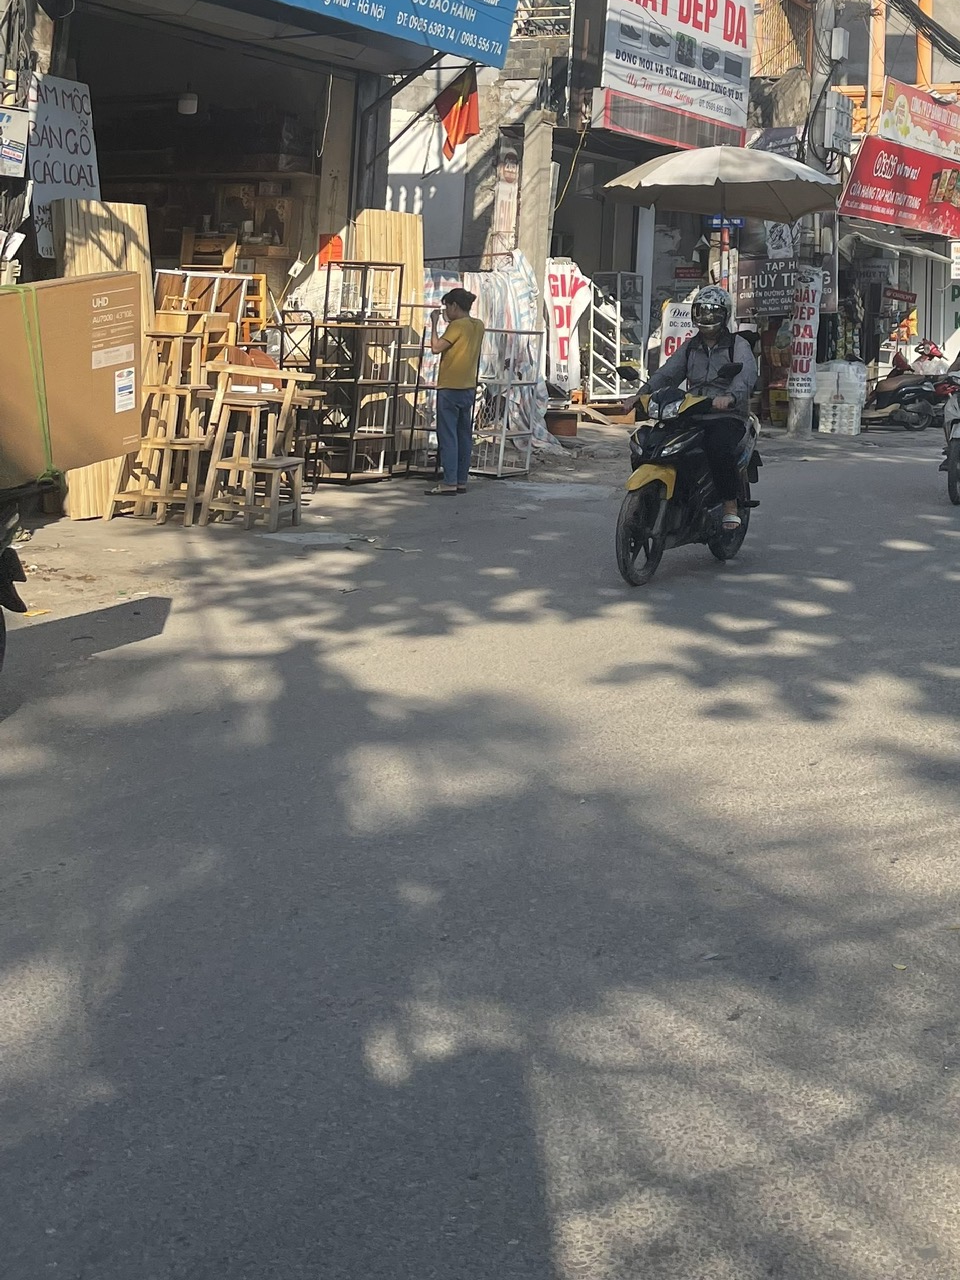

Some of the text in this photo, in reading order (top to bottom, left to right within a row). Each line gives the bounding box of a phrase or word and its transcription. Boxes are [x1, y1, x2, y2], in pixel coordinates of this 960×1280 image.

[370, 4, 386, 22] Nội
[445, 26, 456, 41] 74
[450, 0, 477, 23] HÀNH
[62, 87, 92, 120] MỘC
[28, 114, 92, 156] BÁN GỖ
[32, 153, 62, 185] CÁC
[63, 163, 97, 191] LOẠI
[766, 261, 785, 273] TẠP
[740, 271, 778, 290] THÙY
[92, 296, 109, 308] UHD
[792, 323, 814, 339] DA
